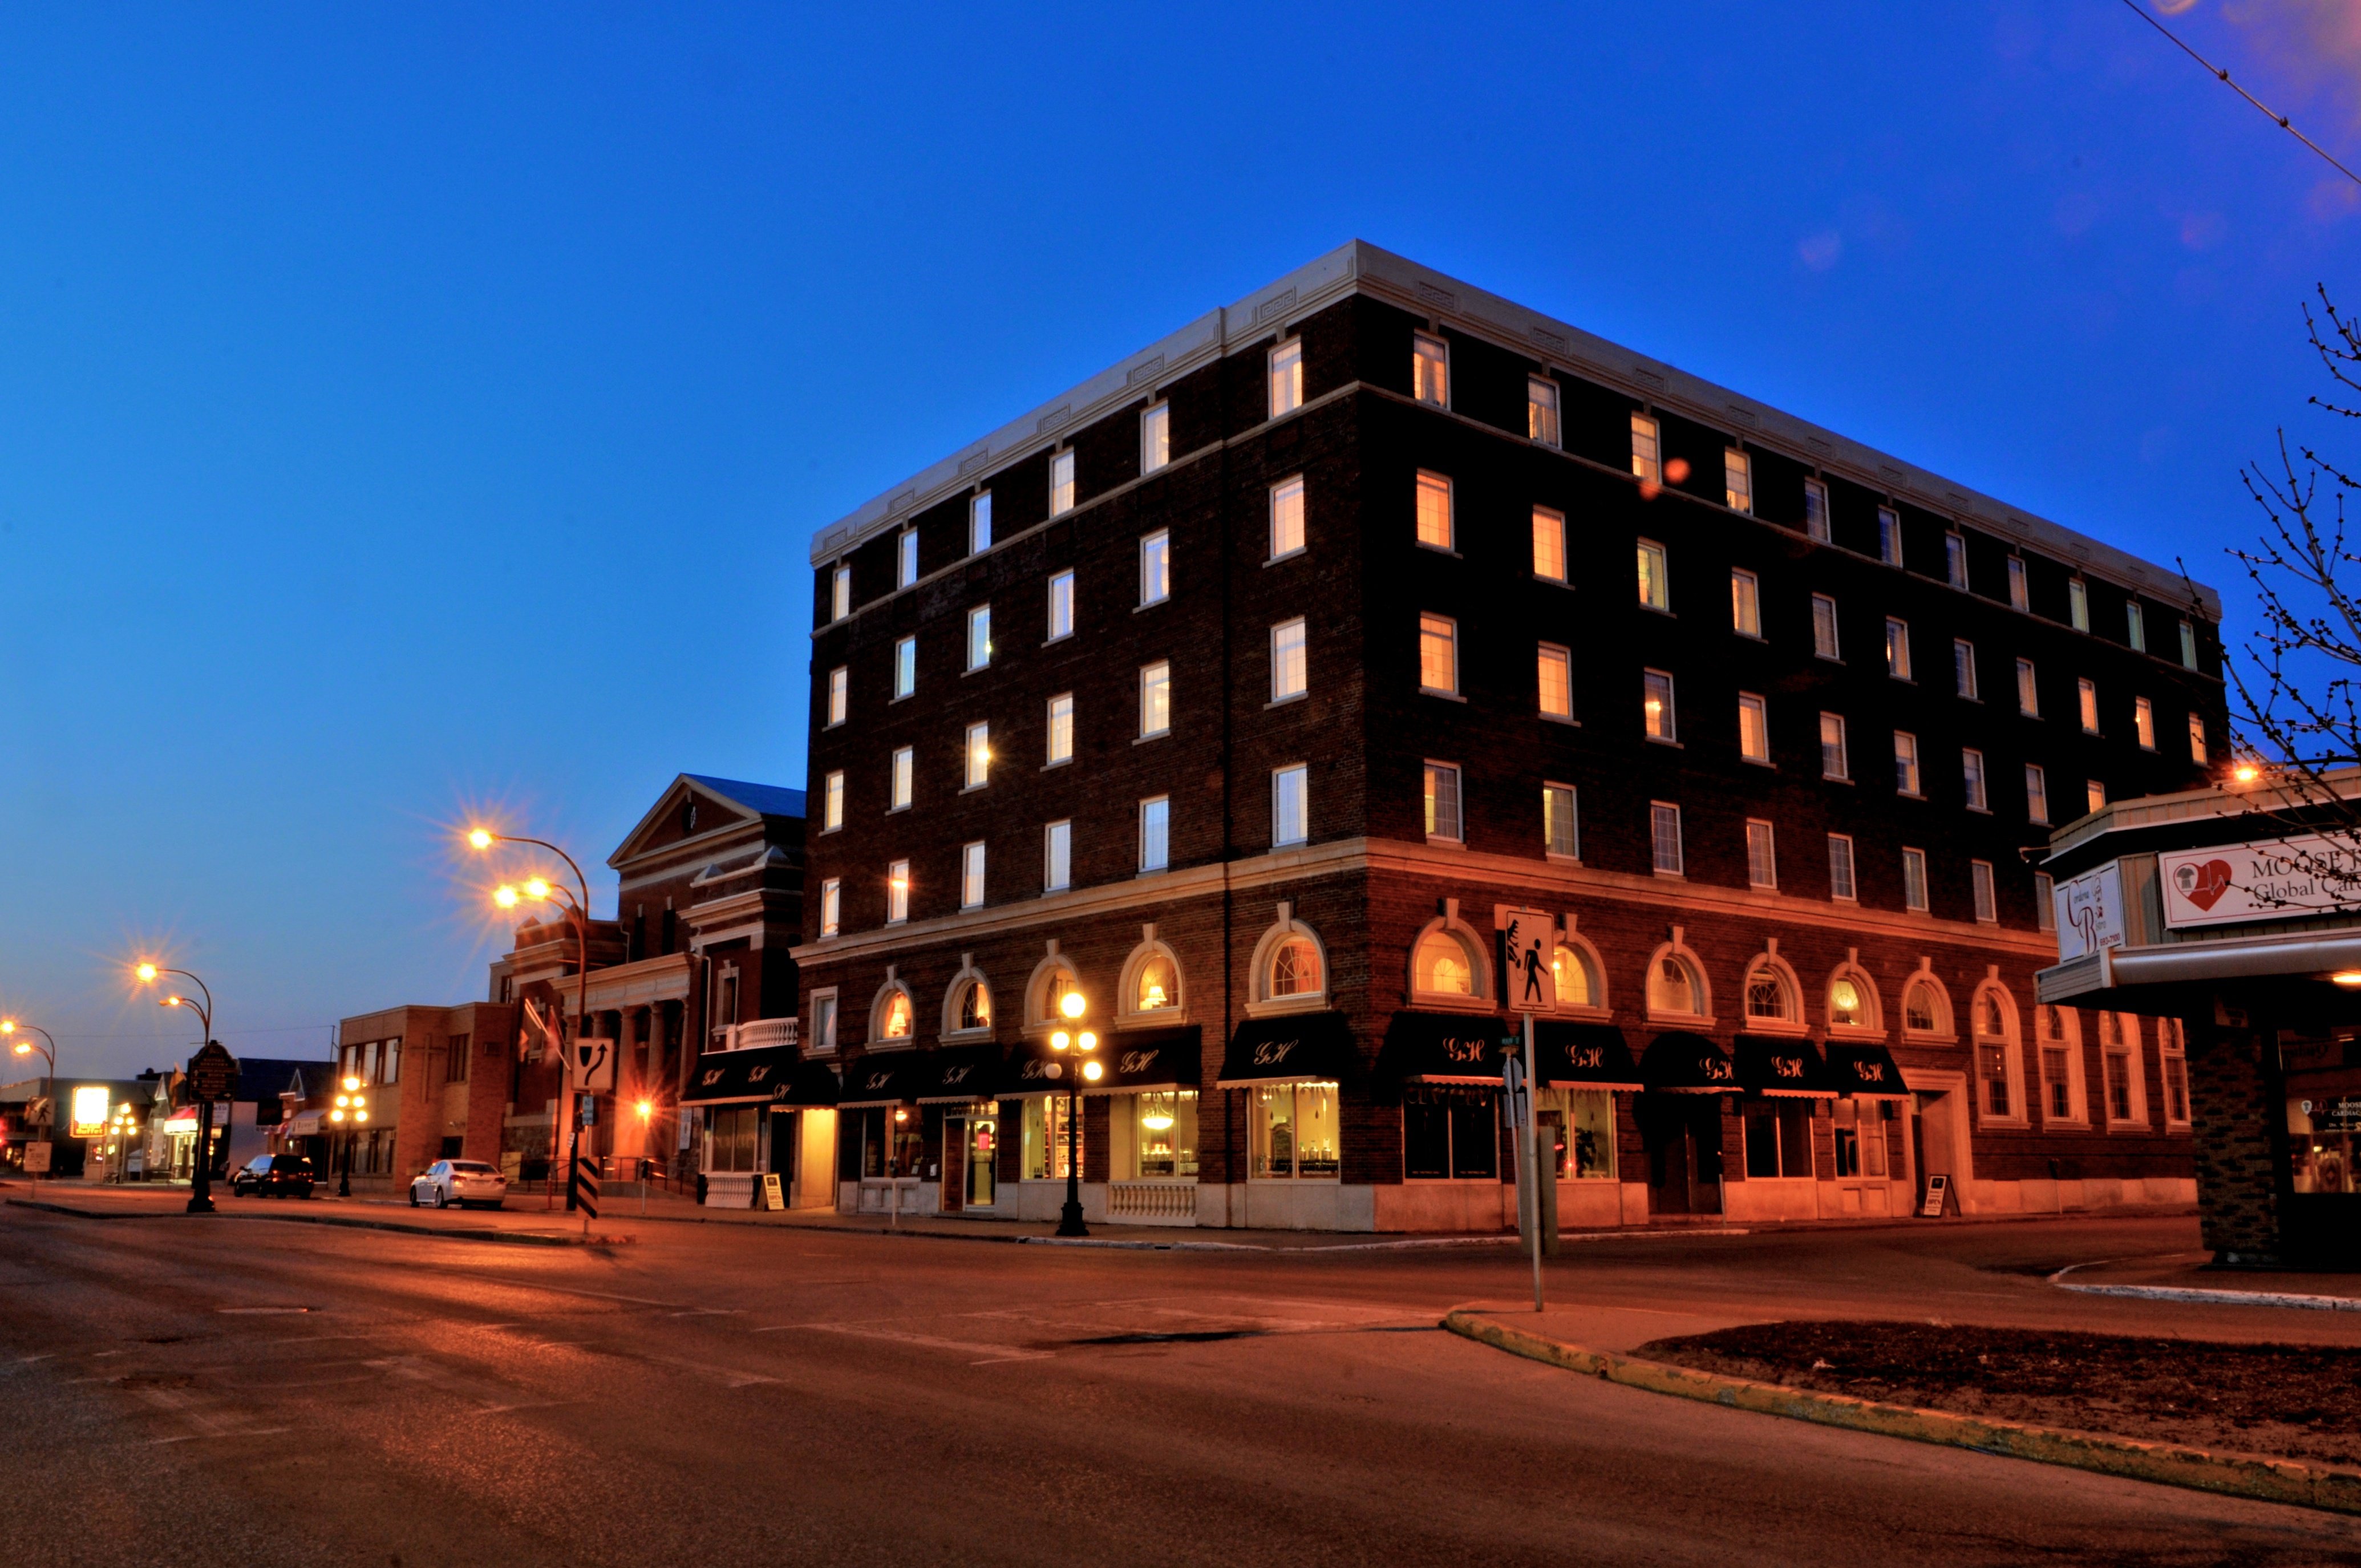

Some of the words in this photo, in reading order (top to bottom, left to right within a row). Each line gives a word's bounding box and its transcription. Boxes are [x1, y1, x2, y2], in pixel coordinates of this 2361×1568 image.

[2251, 850, 2343, 878] MOOSE
[2254, 879, 2315, 901] Global
[1443, 1038, 1485, 1061] GH
[1565, 1045, 1603, 1067] GH
[1771, 1056, 1804, 1077] GH
